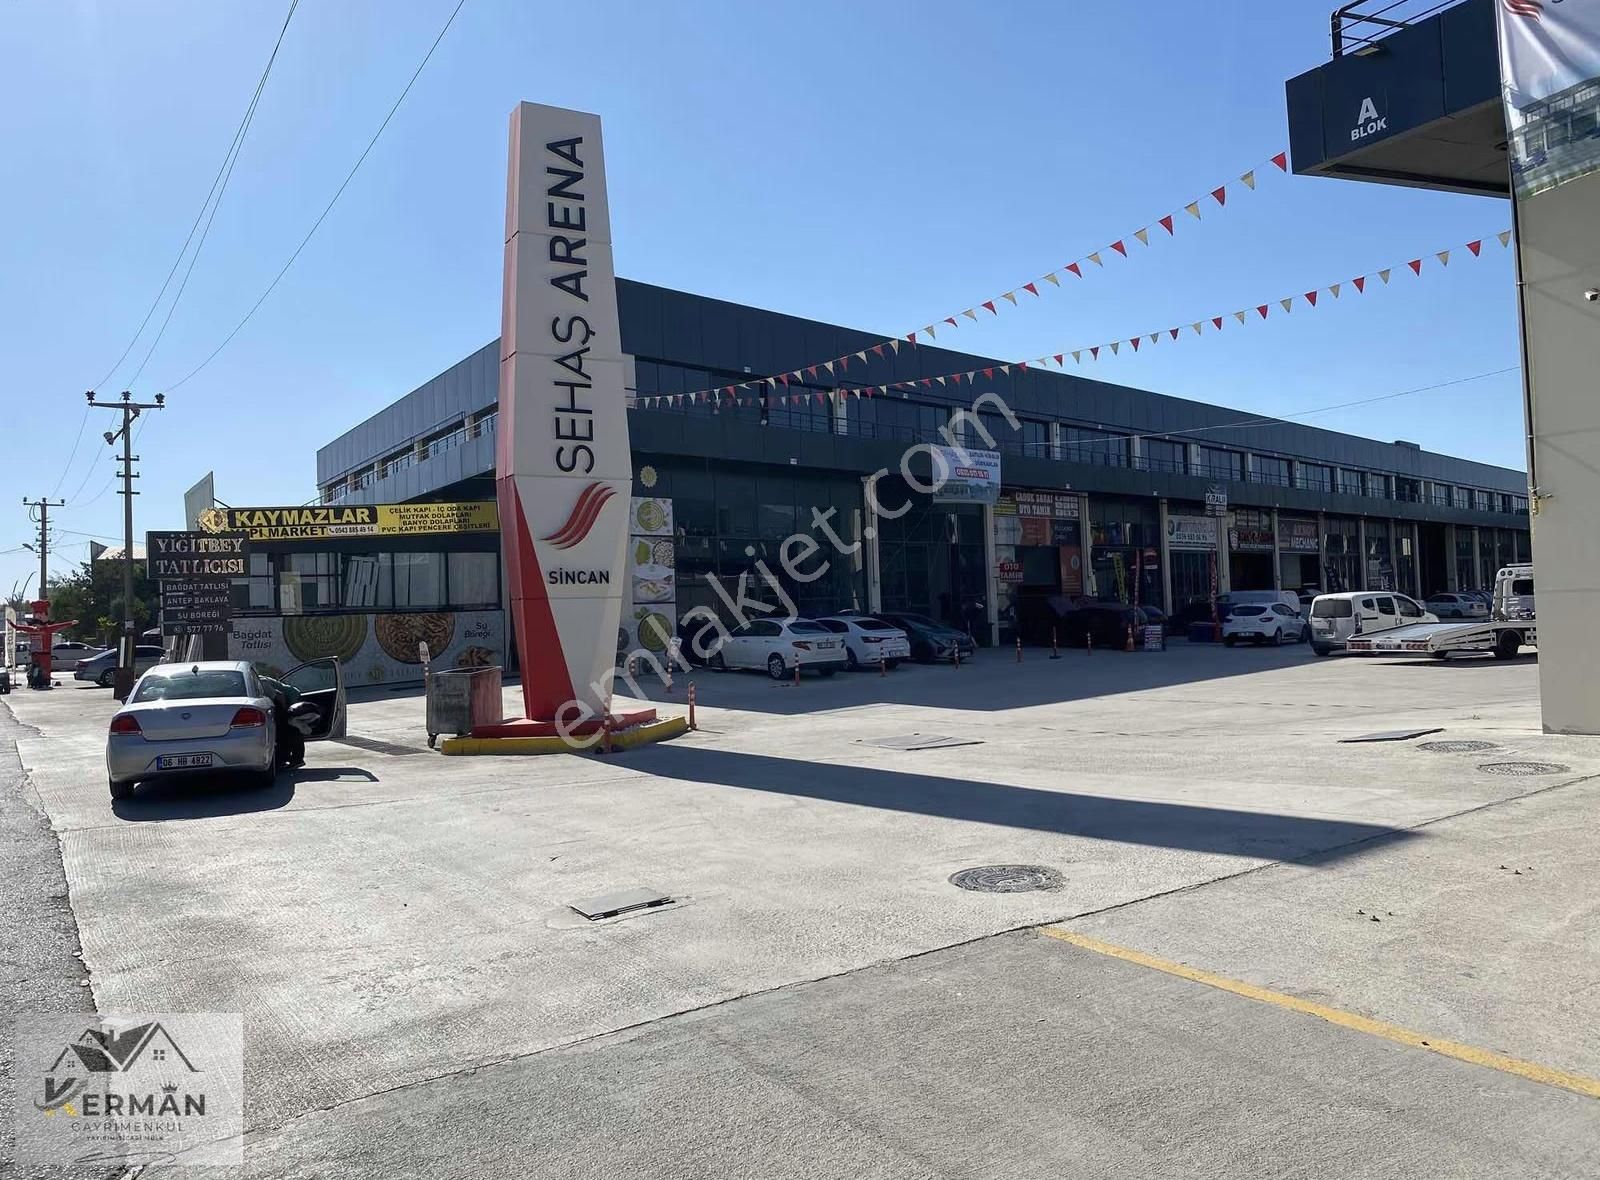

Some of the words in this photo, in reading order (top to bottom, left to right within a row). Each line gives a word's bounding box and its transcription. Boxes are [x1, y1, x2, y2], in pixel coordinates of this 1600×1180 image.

[1357, 96, 1378, 126] A
[1351, 117, 1387, 141] BLOK
[546, 136, 589, 303] ARENA
[551, 314, 595, 474] SEHAŞ
[234, 508, 371, 527] KAYMAZLAR
[389, 506, 411, 514] ÇELİK
[268, 526, 328, 538] MARKET
[156, 534, 244, 553] YİĞİTBEY
[156, 559, 245, 574] TATLICISI
[548, 567, 610, 585] SİNCAN
[166, 582, 198, 592] BAĞDAT
[200, 582, 229, 590] TATLISI
[167, 597, 193, 605] ANTEP
[194, 595, 229, 604] BAKLAVA
[190, 610, 220, 619] BÖREĞİ
[476, 621, 488, 630] Su
[163, 758, 173, 767] 06
